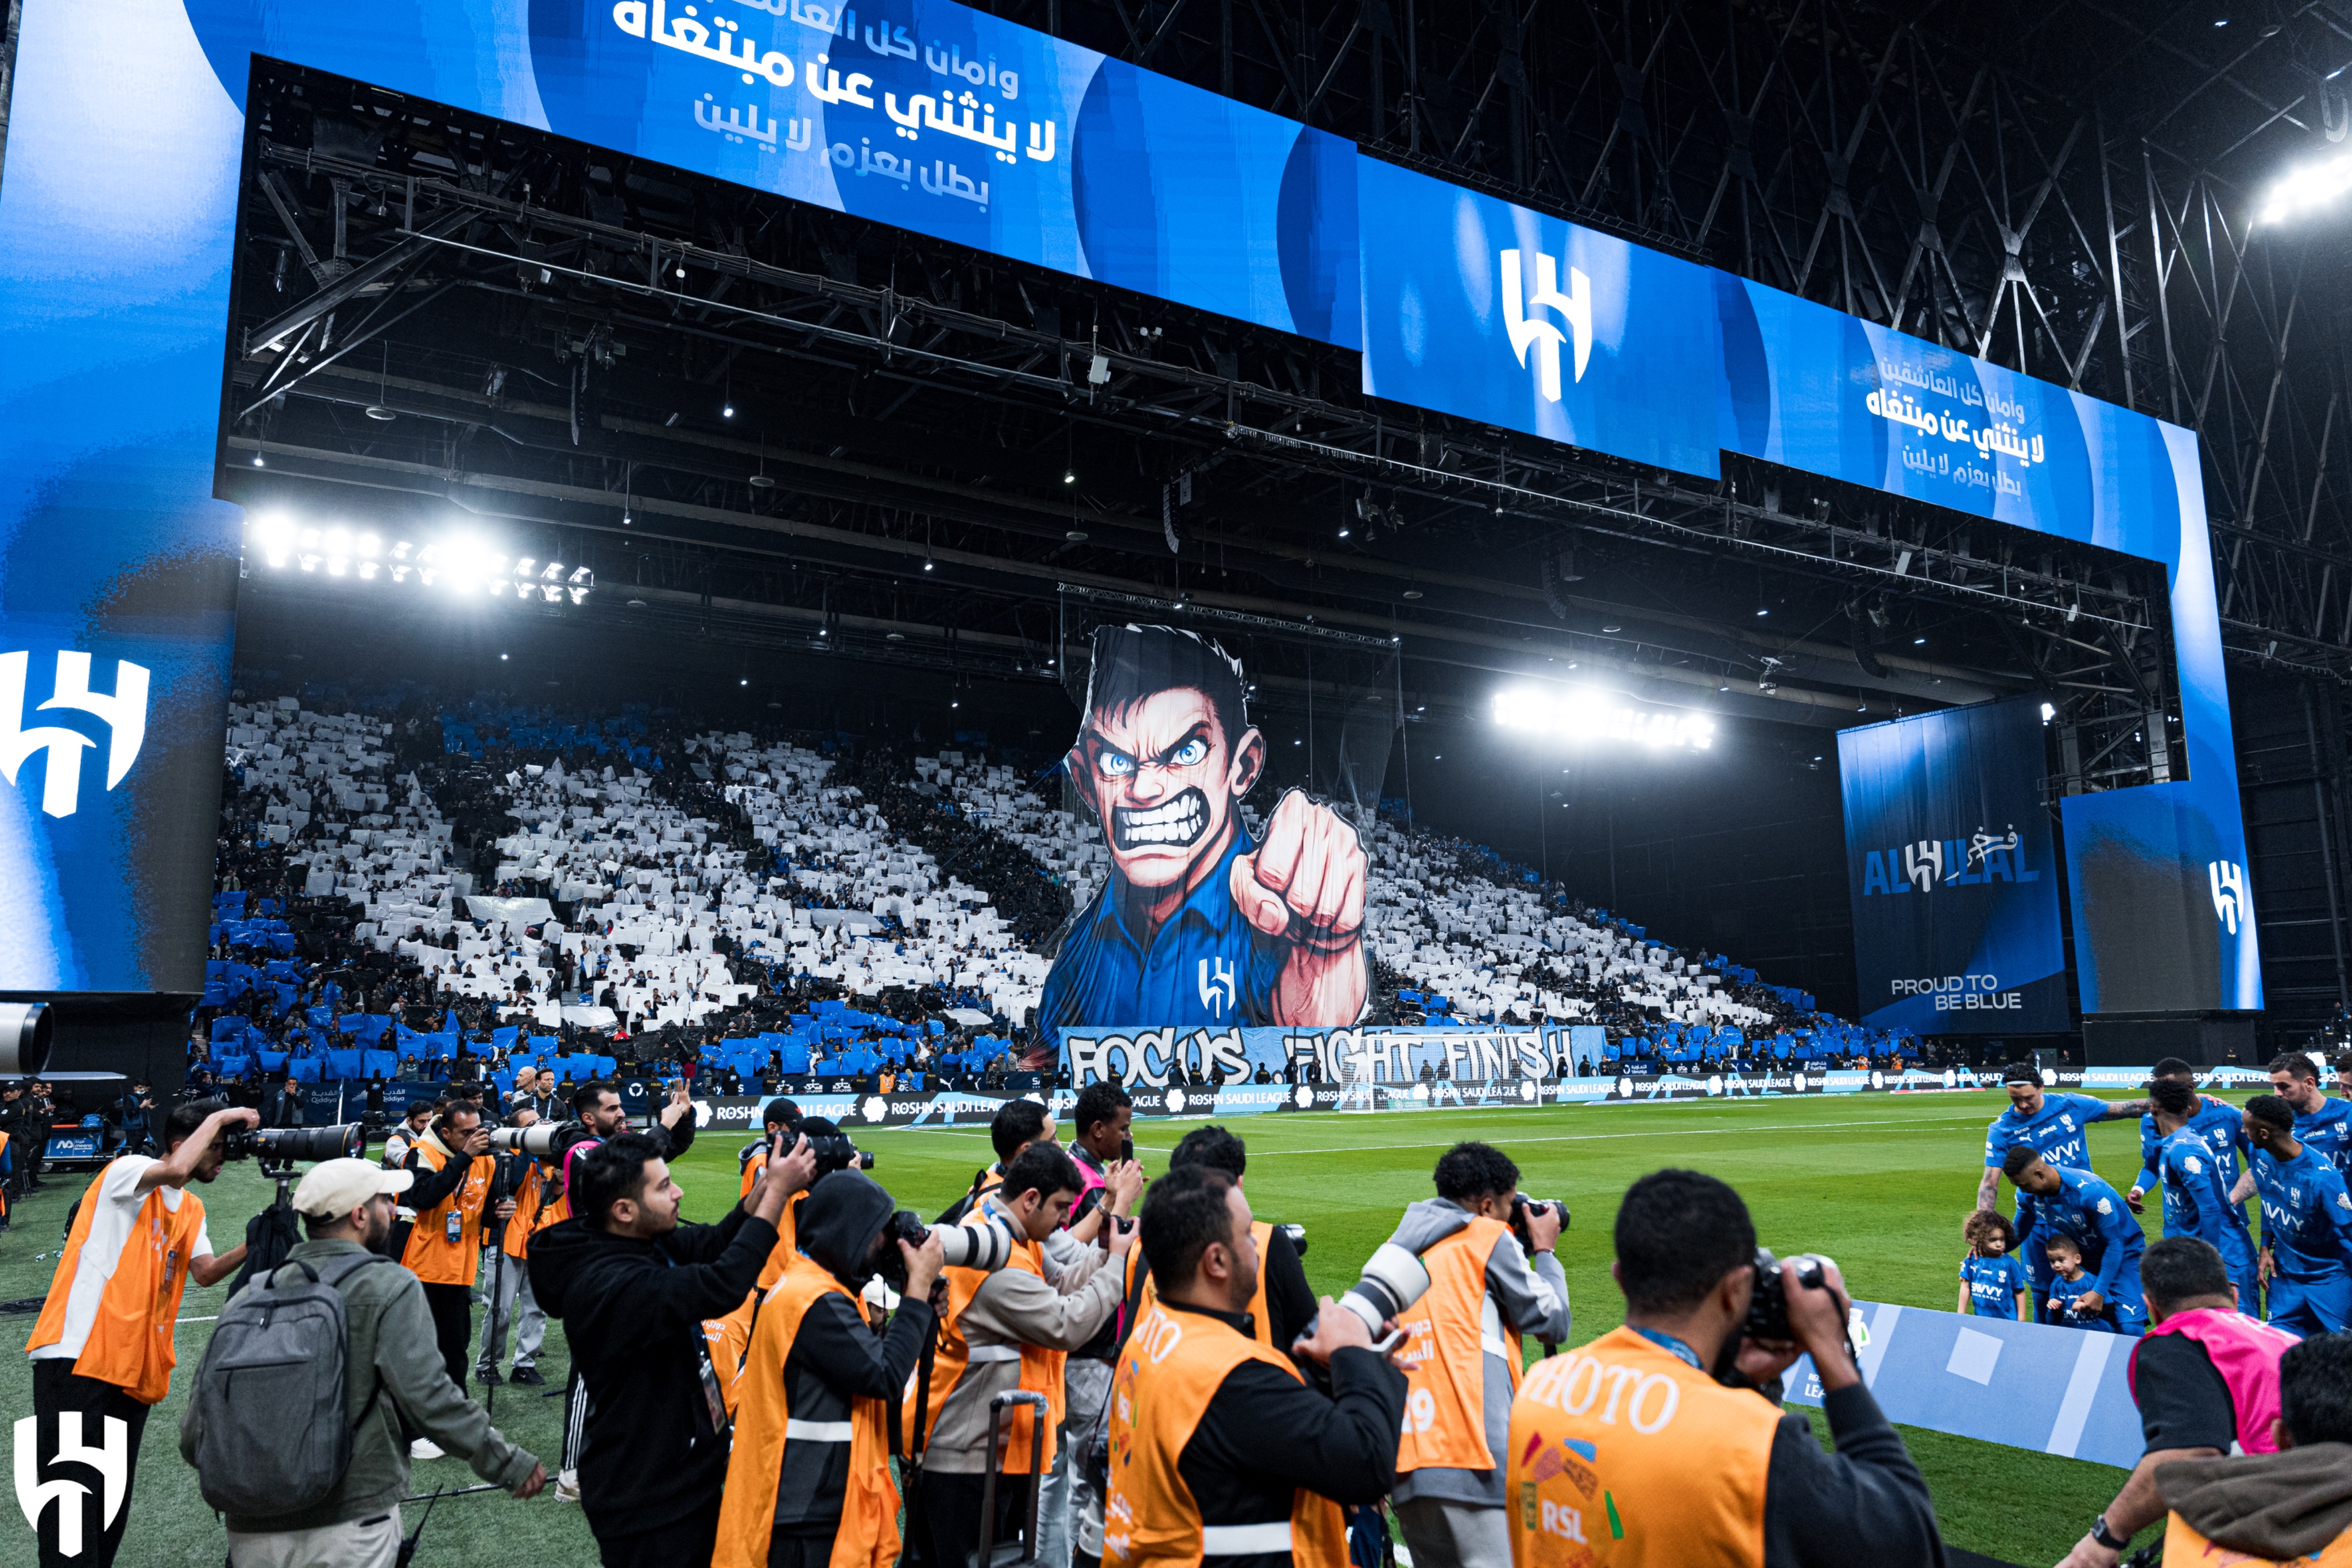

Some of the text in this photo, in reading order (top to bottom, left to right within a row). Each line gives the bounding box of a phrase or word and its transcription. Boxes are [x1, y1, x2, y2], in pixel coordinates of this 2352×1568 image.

[865, 20, 917, 61] كل
[613, 0, 1055, 165] لا ينثني عن مبتغاه
[694, 93, 989, 213] بطل بعزم لا يلين
[1880, 357, 1958, 398] العاشقين
[1960, 382, 1983, 406] كل
[1866, 388, 2044, 467] لا ينثني عن مبتغاه
[1902, 445, 2021, 502] بطل بعزم لا يلين
[1891, 974, 1998, 994] PROUD TO
[1935, 993, 2022, 1011] BE BLUE
[1282, 1027, 1423, 1083] FIGHT
[1724, 1078, 1792, 1089] ROSHN SAUDI LEAGUE
[1807, 1075, 1870, 1086] ROSHN SAUDI LEAGUE
[1885, 1074, 1943, 1084] ROSHN SAUDI LEAGUE
[1957, 1073, 1978, 1082] ROSHN
[2059, 1073, 2154, 1082] ROSHN SAUDI LEAGUE
[2192, 1073, 2214, 1082] SHN
[2215, 1072, 2245, 1082] SAUDI
[1432, 1087, 1460, 1098] ROSHN
[1463, 1086, 1487, 1097] SAUDI
[1540, 1083, 1616, 1095] ROSHN SAUDI LEAGUE
[1635, 1080, 1707, 1091] ROSHN SAUDI LEAGUE
[1048, 1095, 1160, 1110] ROSH AGUE
[1189, 1092, 1291, 1105] ROSHN SAUDI LEAGUE
[1317, 1091, 1348, 1102] ROSHN
[1350, 1090, 1371, 1101] SAUD
[717, 1106, 764, 1120] ROSHN
[811, 1102, 857, 1118] LEAGUE
[892, 1102, 935, 1115] ROSHN
[937, 1101, 972, 1113] SAUDI
[2303, 1129, 2326, 1139] jahez
[2041, 1138, 2080, 1163] AVVY
[1971, 1282, 2003, 1297] SAVVY
[1541, 1499, 1588, 1546] RSL
